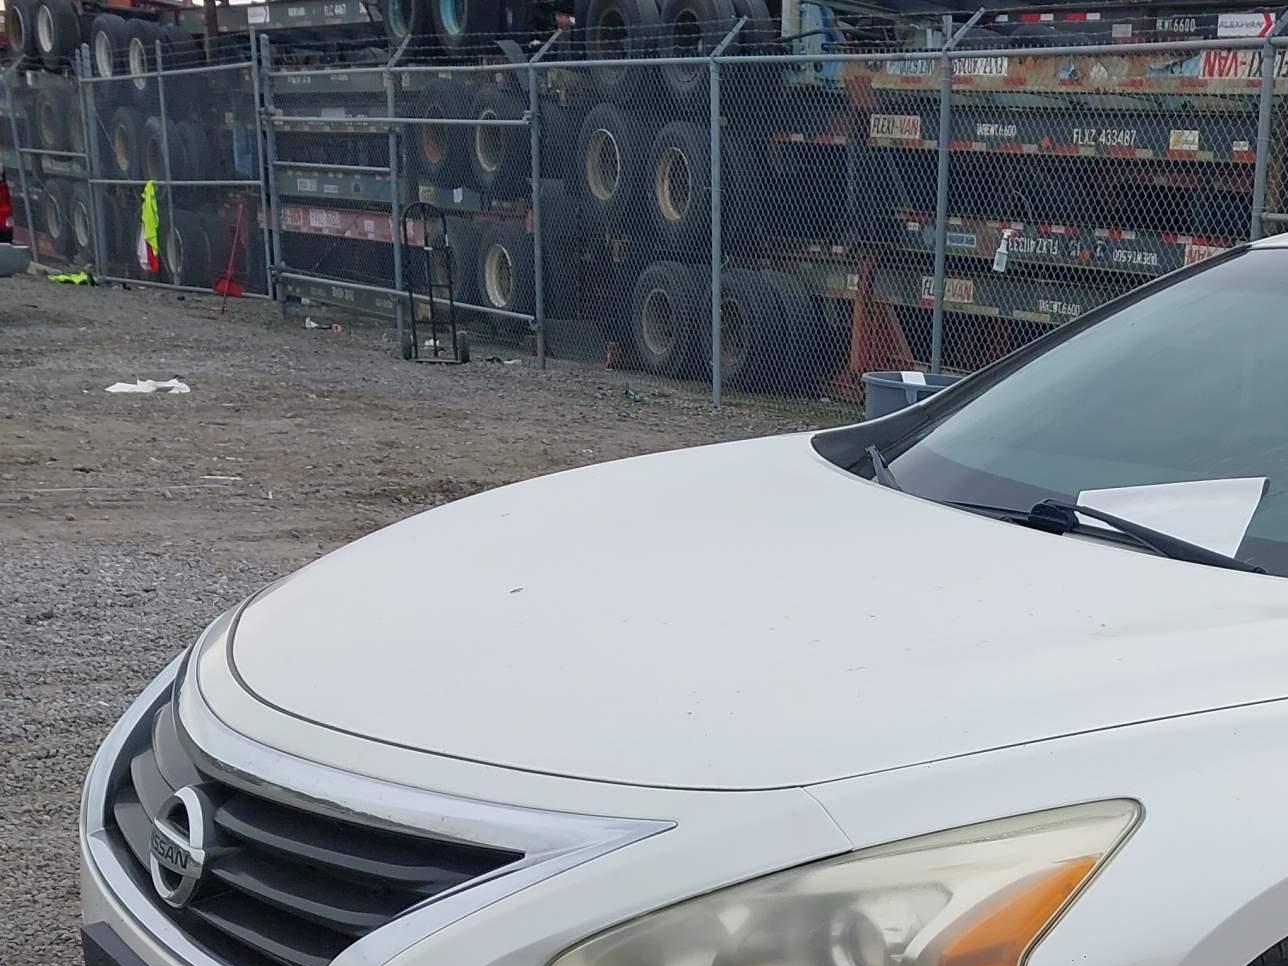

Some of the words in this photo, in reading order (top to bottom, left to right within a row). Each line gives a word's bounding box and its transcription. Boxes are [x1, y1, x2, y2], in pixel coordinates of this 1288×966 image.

[1072, 128, 1097, 145] FLXZ
[1099, 129, 1137, 146] 433487
[151, 834, 190, 870] SSAN
